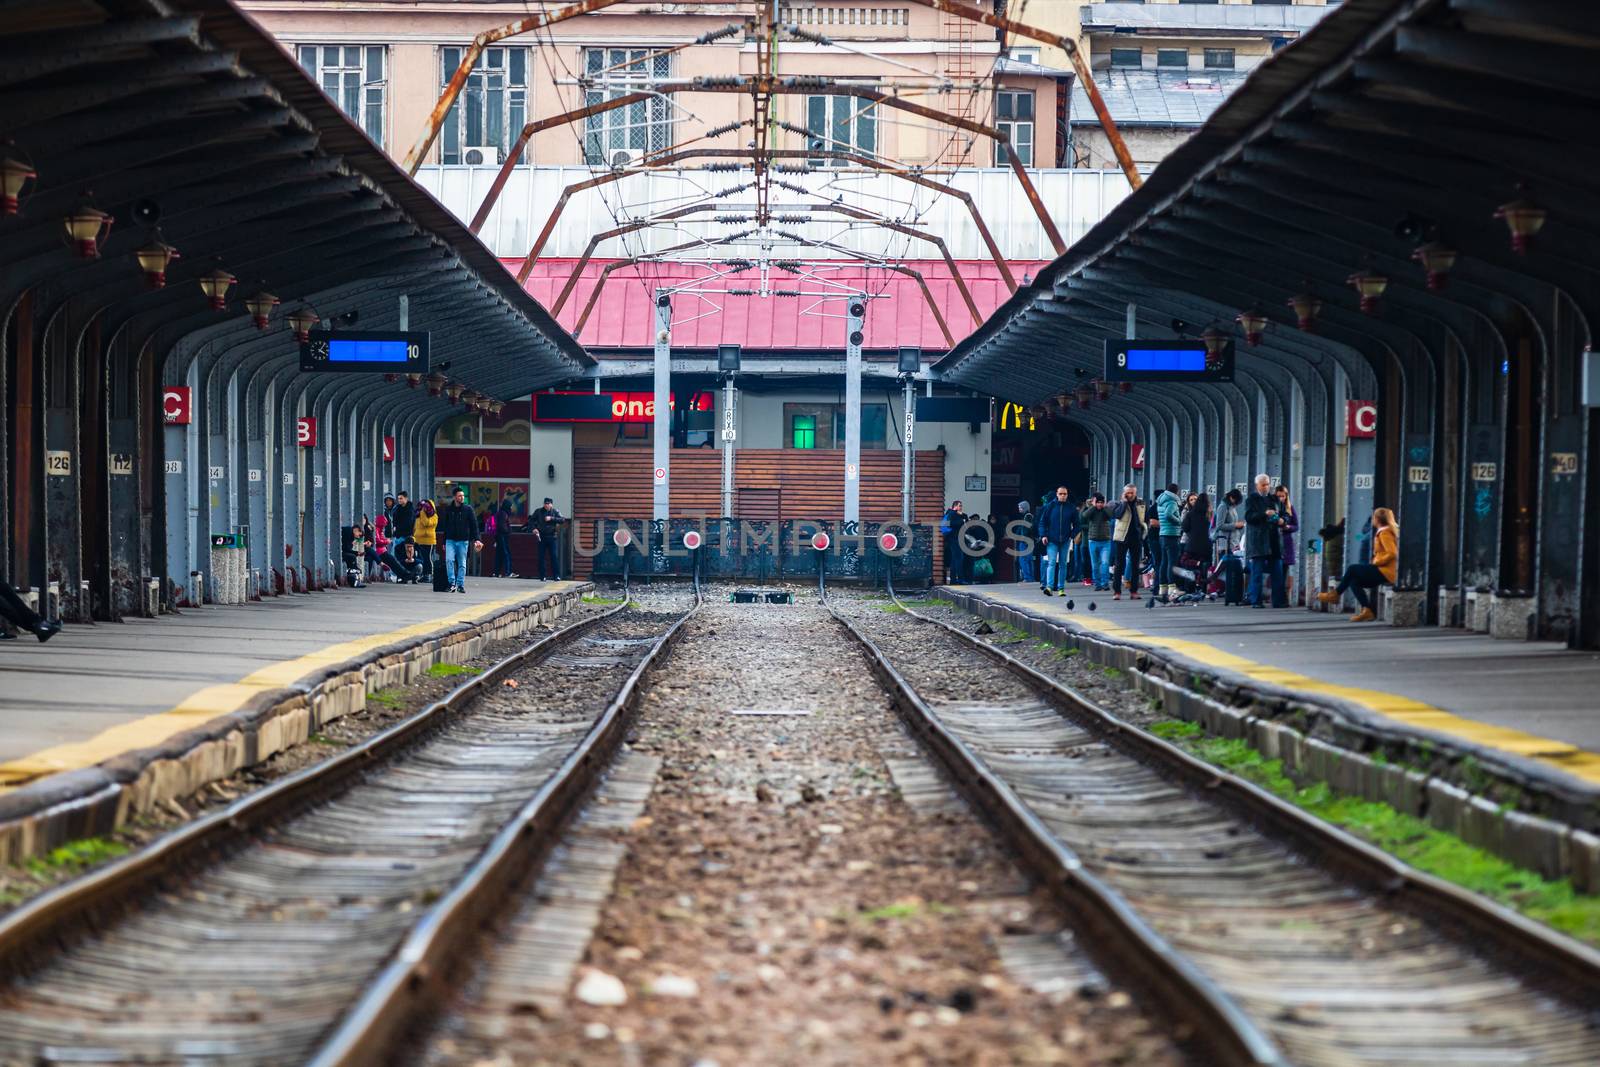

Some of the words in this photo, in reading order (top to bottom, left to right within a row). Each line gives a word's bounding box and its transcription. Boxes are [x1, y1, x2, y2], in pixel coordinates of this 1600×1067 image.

[407, 345, 419, 358] 10
[1117, 353, 1126, 367] 9
[164, 392, 182, 416] C
[1355, 406, 1377, 432] C
[298, 422, 310, 441] B
[49, 457, 69, 470] 126
[472, 455, 490, 472] M
[1411, 469, 1429, 481] 112
[1473, 464, 1496, 478] 126
[1356, 477, 1370, 487] 98
